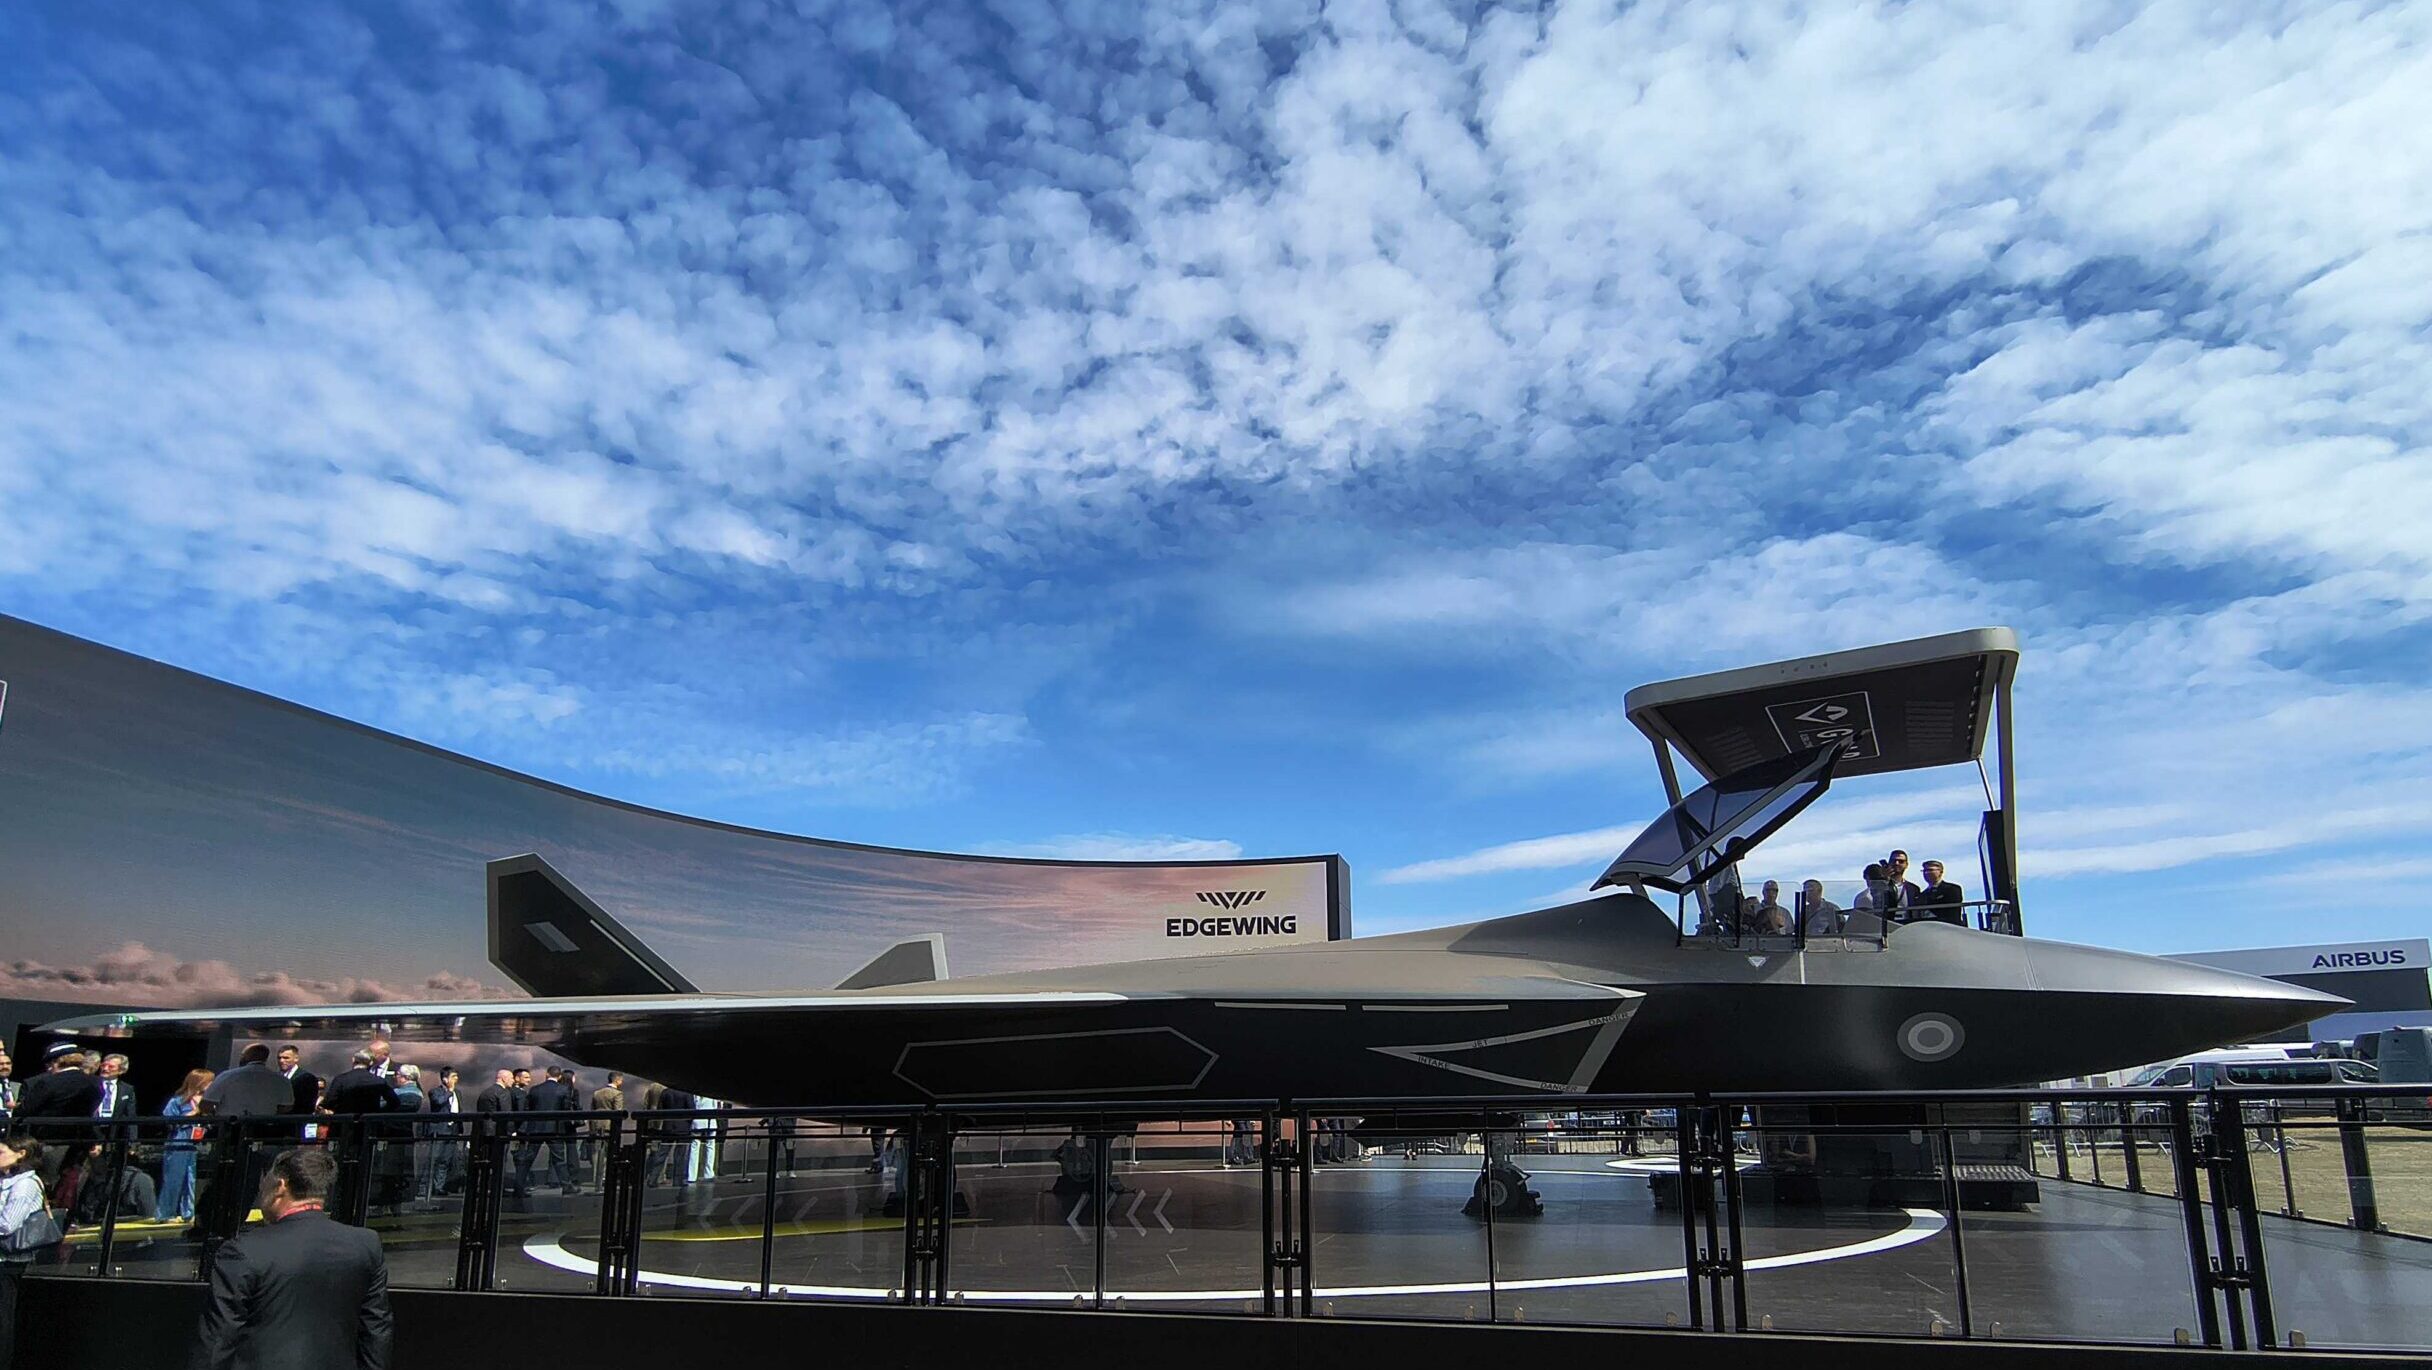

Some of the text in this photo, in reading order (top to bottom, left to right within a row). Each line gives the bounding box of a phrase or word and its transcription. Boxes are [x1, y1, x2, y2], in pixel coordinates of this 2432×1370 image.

[1167, 916, 1295, 936] EDGEWING
[2312, 950, 2405, 968] AIRBUS
[1472, 1013, 1629, 1049] JET DANGER
[1417, 1056, 1578, 1093] INTAKE DANGER
